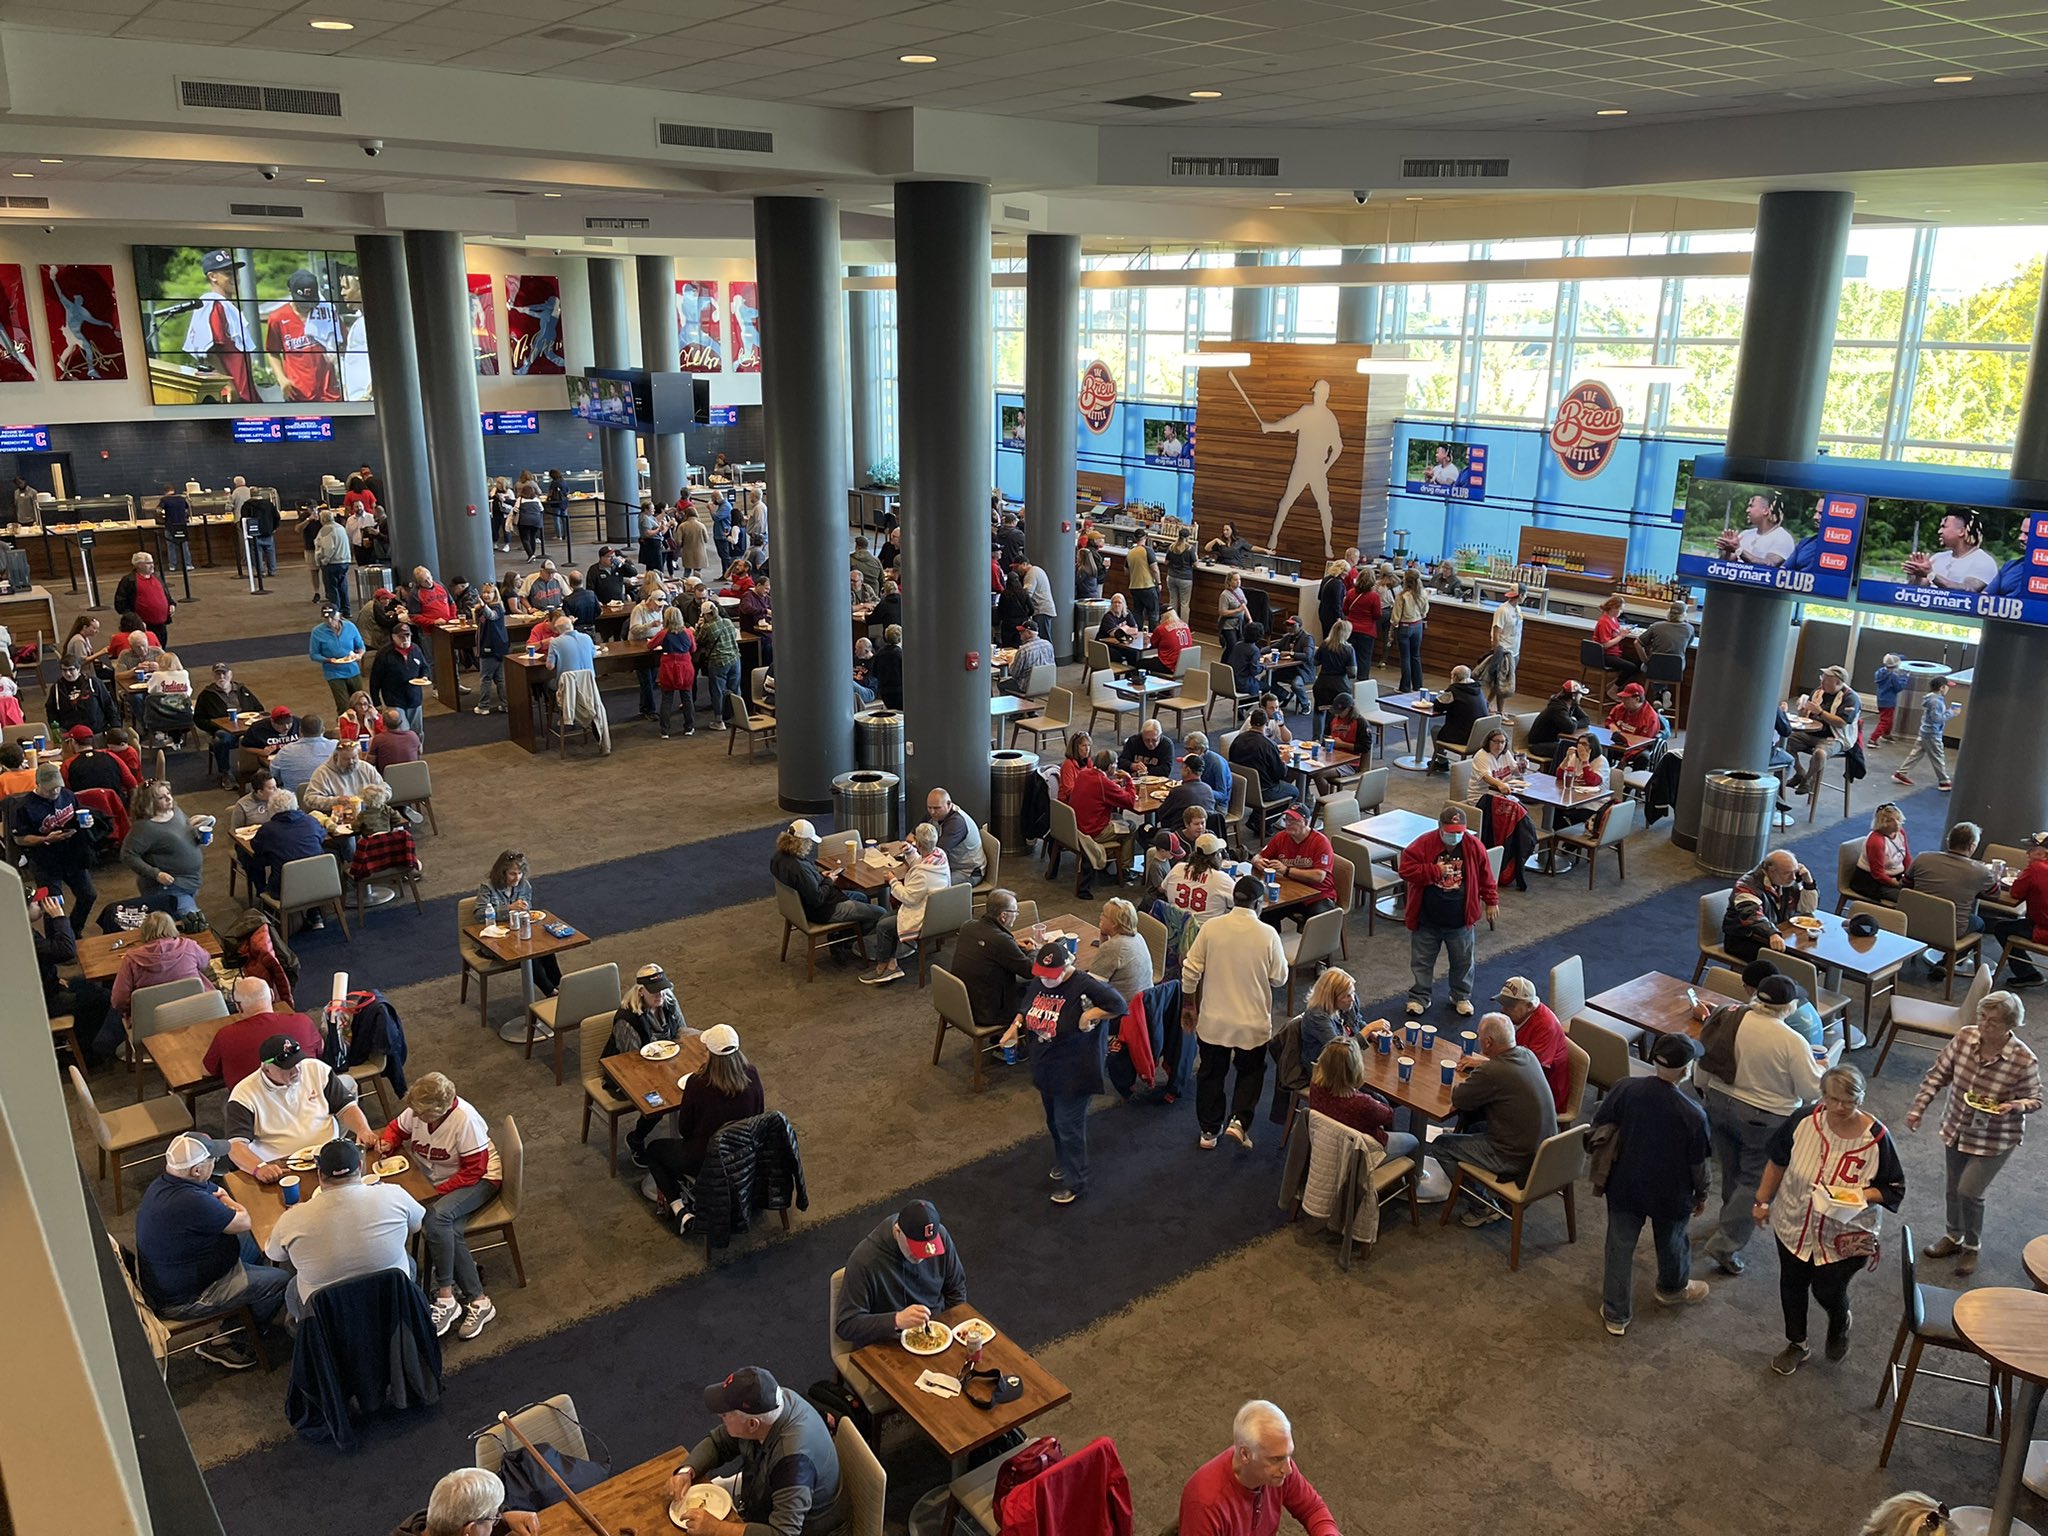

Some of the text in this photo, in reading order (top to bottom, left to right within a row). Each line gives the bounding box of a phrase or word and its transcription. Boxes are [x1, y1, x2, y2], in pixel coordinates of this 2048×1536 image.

[1080, 375, 1117, 411] Brew
[1582, 390, 1598, 402] THE
[321, 423, 331, 436] C
[485, 418, 494, 430] C
[527, 417, 536, 429] C
[1553, 400, 1622, 447] Brew
[271, 424, 281, 438] C
[35, 432, 47, 446] C
[1565, 446, 1601, 462] KETTLE
[1420, 485, 1435, 495] drug
[1451, 487, 1469, 498] CLUB
[1830, 503, 1854, 515] Hartz
[1826, 529, 1850, 541] Hartz
[1726, 562, 1754, 571] DISCOUNT
[1821, 555, 1845, 567] Hartz
[1707, 563, 1815, 592] drug mart CLUB
[1917, 587, 1951, 597] DISCOUNT
[1895, 589, 2023, 620] drug mart CLUB
[1176, 630, 1188, 646] 11
[1175, 883, 1207, 912] 38
[1032, 994, 1066, 1013] PARTY
[1838, 1156, 1867, 1184] C
[924, 1223, 934, 1238] C
[722, 1373, 734, 1388] C
